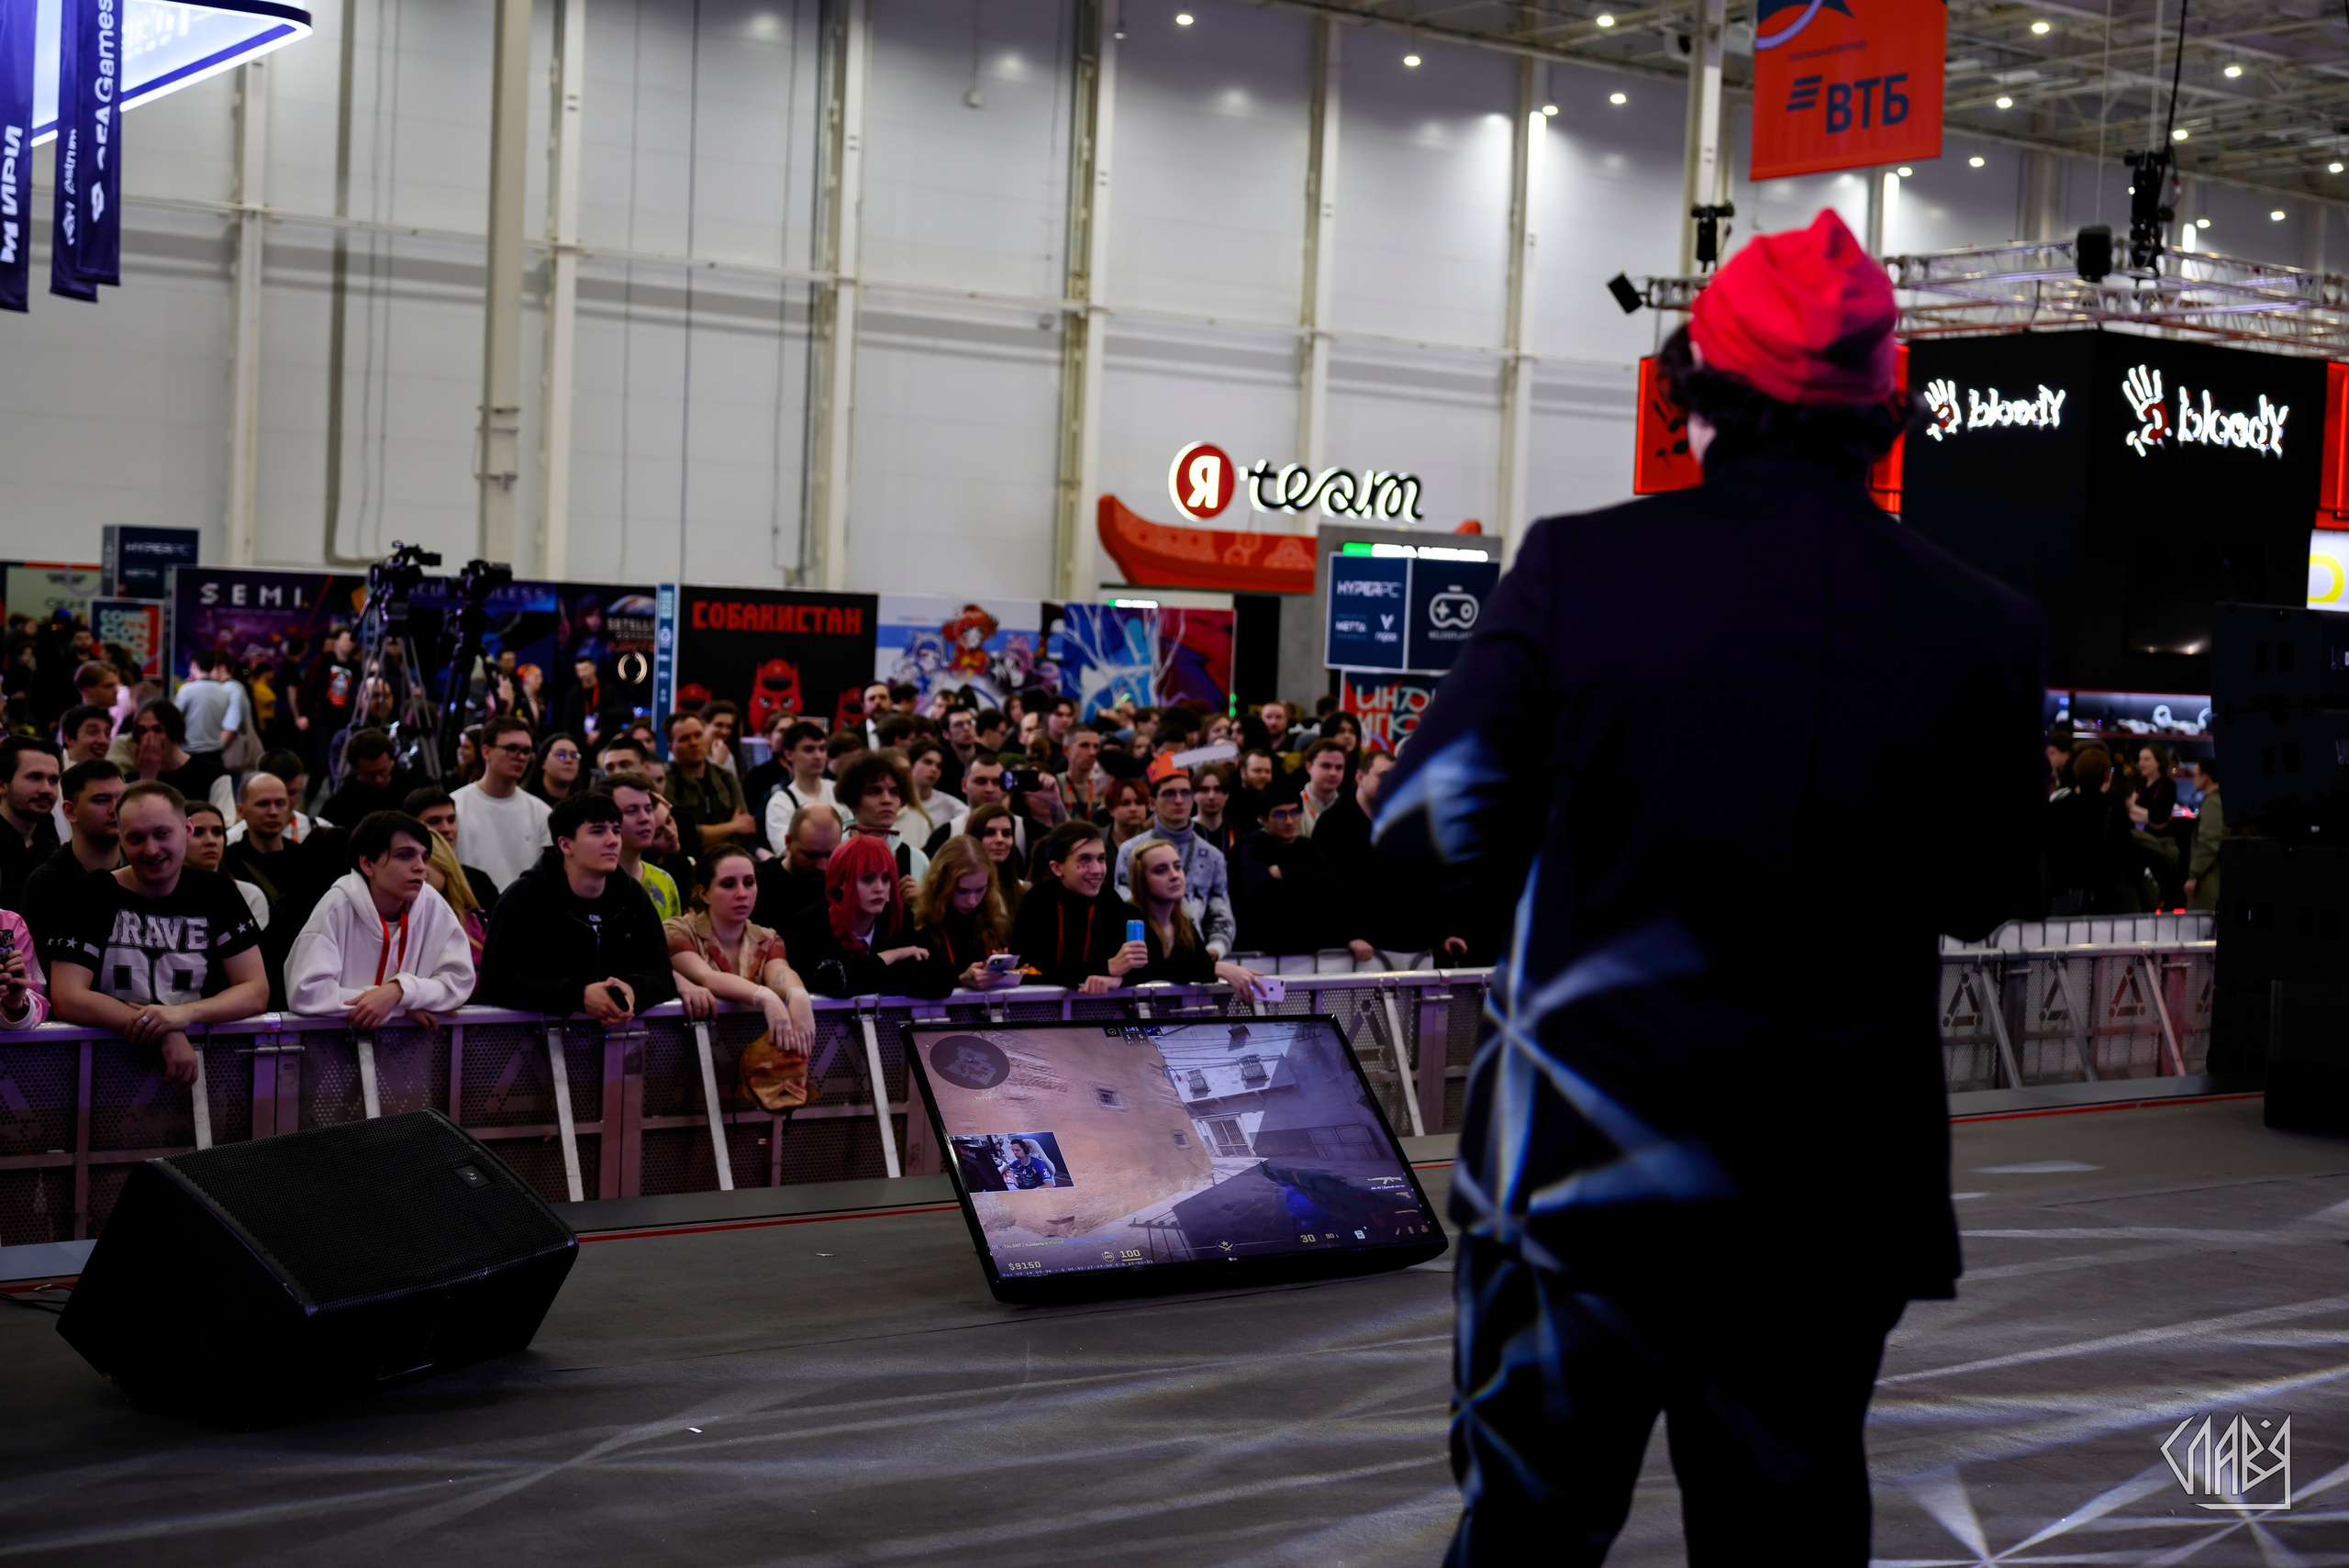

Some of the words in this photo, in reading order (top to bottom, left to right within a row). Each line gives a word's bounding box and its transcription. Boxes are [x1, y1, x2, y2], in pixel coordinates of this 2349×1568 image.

[1825, 72, 1909, 134] ВТБ
[1186, 455, 1221, 508] Я
[1238, 458, 1424, 524] team
[1337, 580, 1402, 598] HYPERPC
[692, 601, 863, 635] СОБАКИСТАН
[1300, 1234, 1316, 1243] 30
[1119, 1249, 1141, 1258] 100
[1008, 1261, 1041, 1271] $9150
